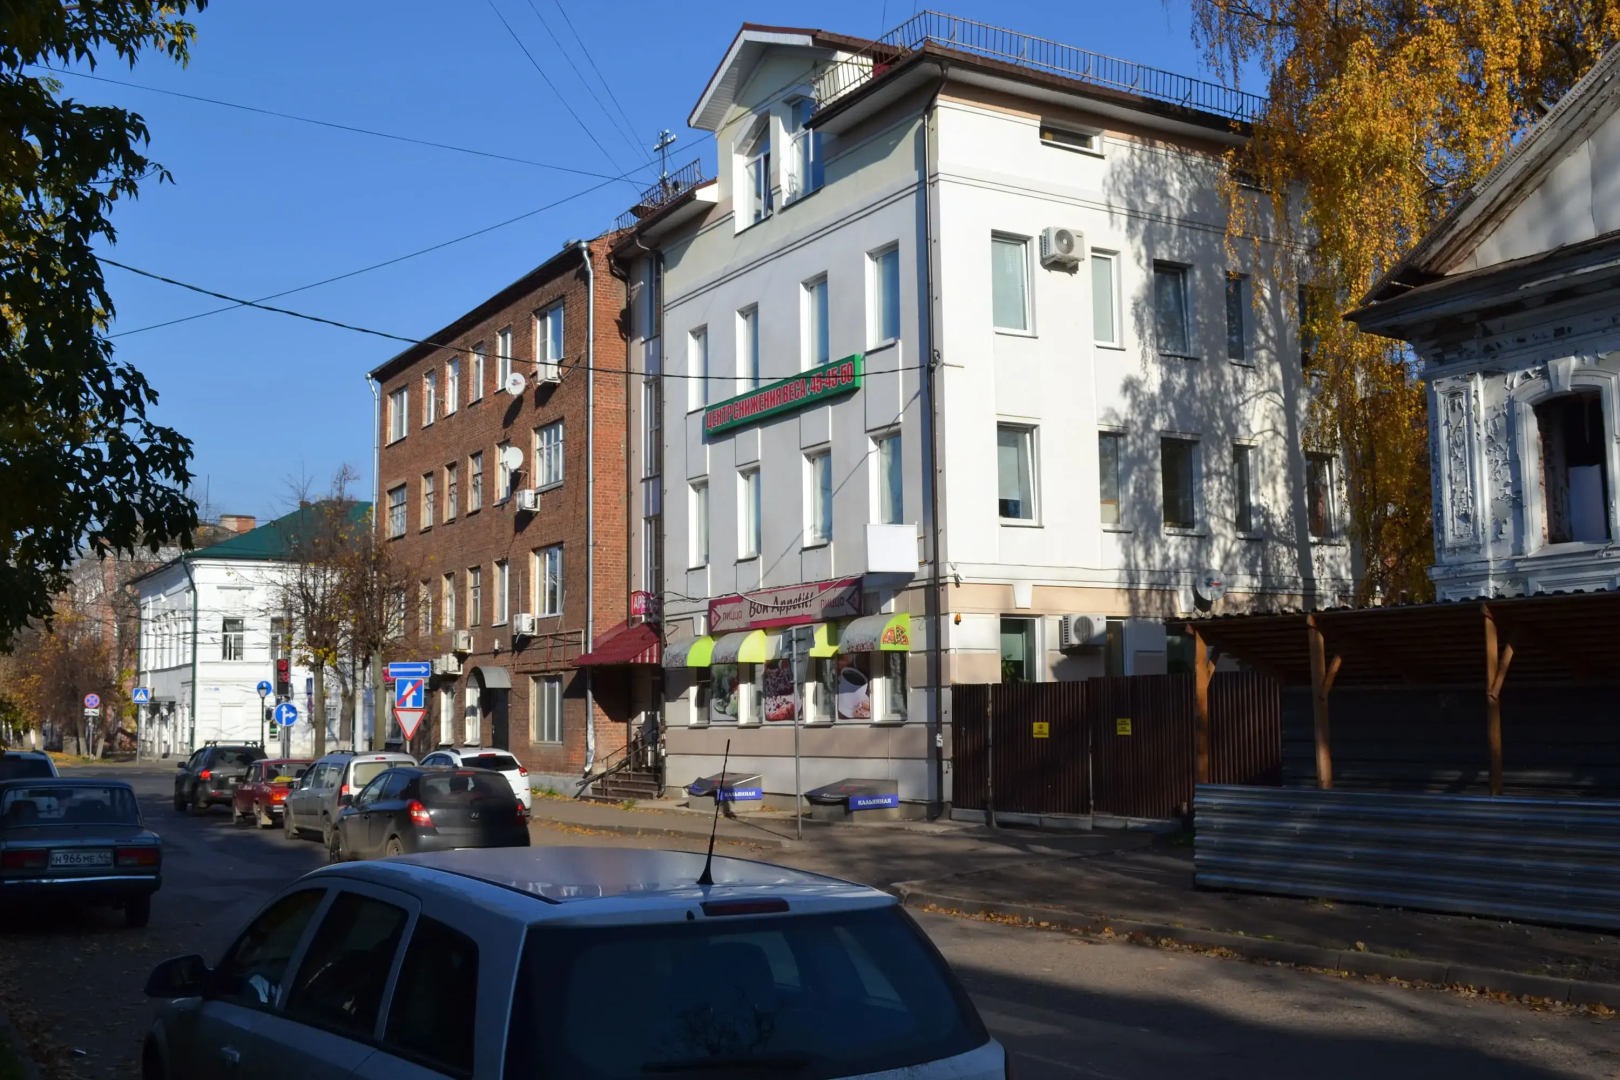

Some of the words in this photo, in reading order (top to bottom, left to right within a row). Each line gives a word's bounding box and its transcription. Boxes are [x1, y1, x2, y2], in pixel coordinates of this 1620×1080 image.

[706, 408, 732, 430] ЦЕНТР
[733, 389, 781, 419] СНИЖЕНИЯ
[782, 378, 806, 403] ВЕСА
[749, 599, 769, 618] Bon
[771, 592, 814, 616] Appetit!
